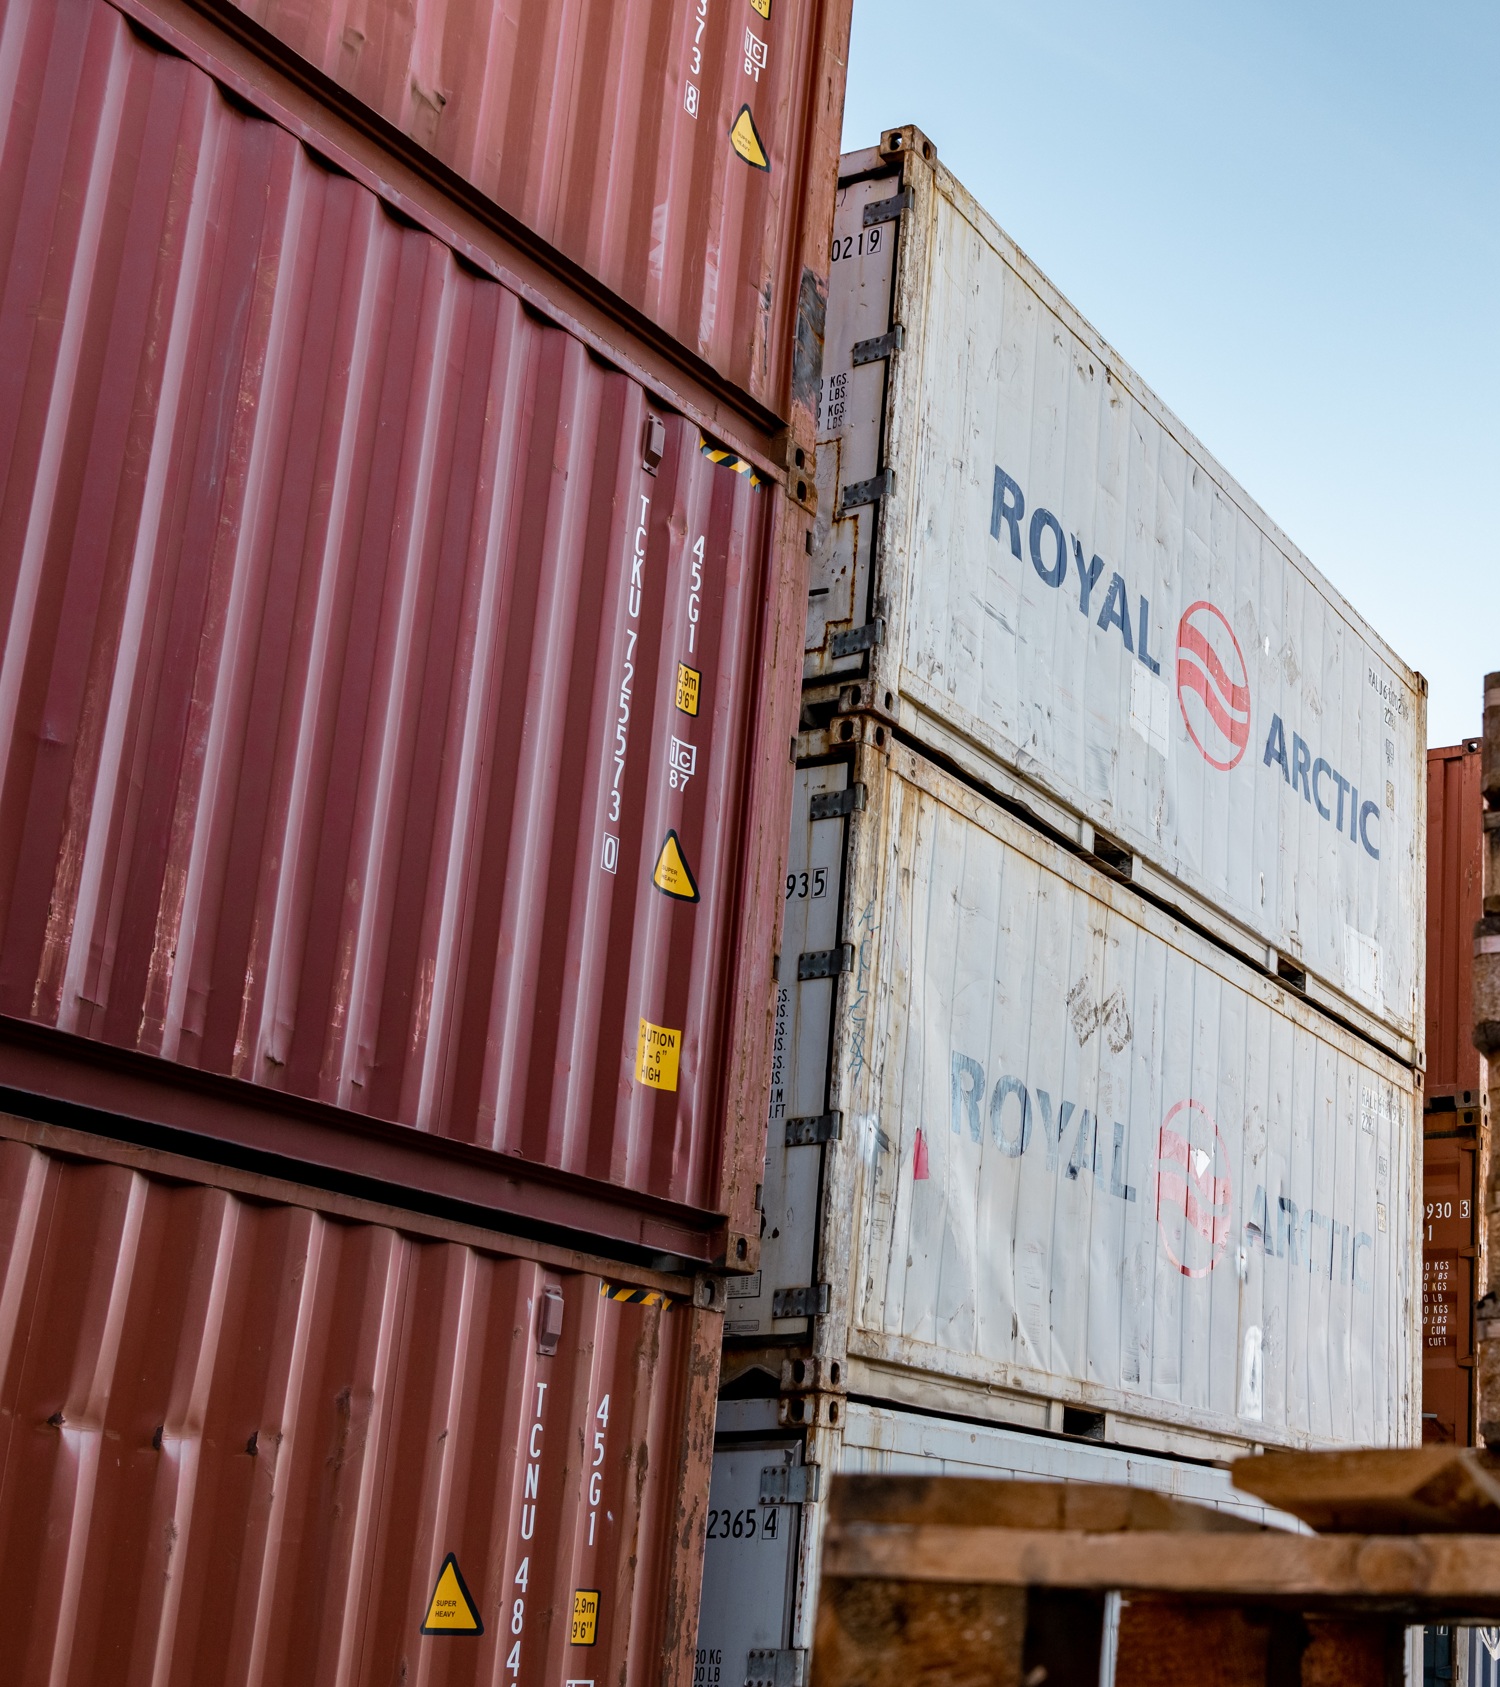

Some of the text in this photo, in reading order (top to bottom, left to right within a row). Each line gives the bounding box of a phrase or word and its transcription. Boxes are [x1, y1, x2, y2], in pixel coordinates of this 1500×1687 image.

[744, 58, 760, 82] 81
[628, 494, 650, 618] TCKU
[989, 464, 1161, 676] ROYAL
[688, 535, 705, 653] 45G1
[678, 667, 697, 691] 2,9m
[608, 628, 638, 822] 725573
[669, 769, 690, 792] 87
[1262, 712, 1381, 860] ARCTIC
[951, 1050, 1136, 1202] ROYAL
[1423, 1201, 1452, 1219] 930
[1434, 1261, 1449, 1271] KGS
[1432, 1282, 1447, 1292] KGS
[1433, 1304, 1448, 1314] KGS
[1431, 1316, 1447, 1324] LBS
[1431, 1325, 1447, 1335] CUM
[1428, 1337, 1447, 1346] CUFT
[588, 1393, 609, 1546] 45G1
[506, 1382, 547, 1687] TCNU 484
[435, 1610, 456, 1618] HEAVY
[574, 1597, 595, 1616] 2,9m
[709, 1649, 721, 1664] KG
[708, 1667, 720, 1682] LB
